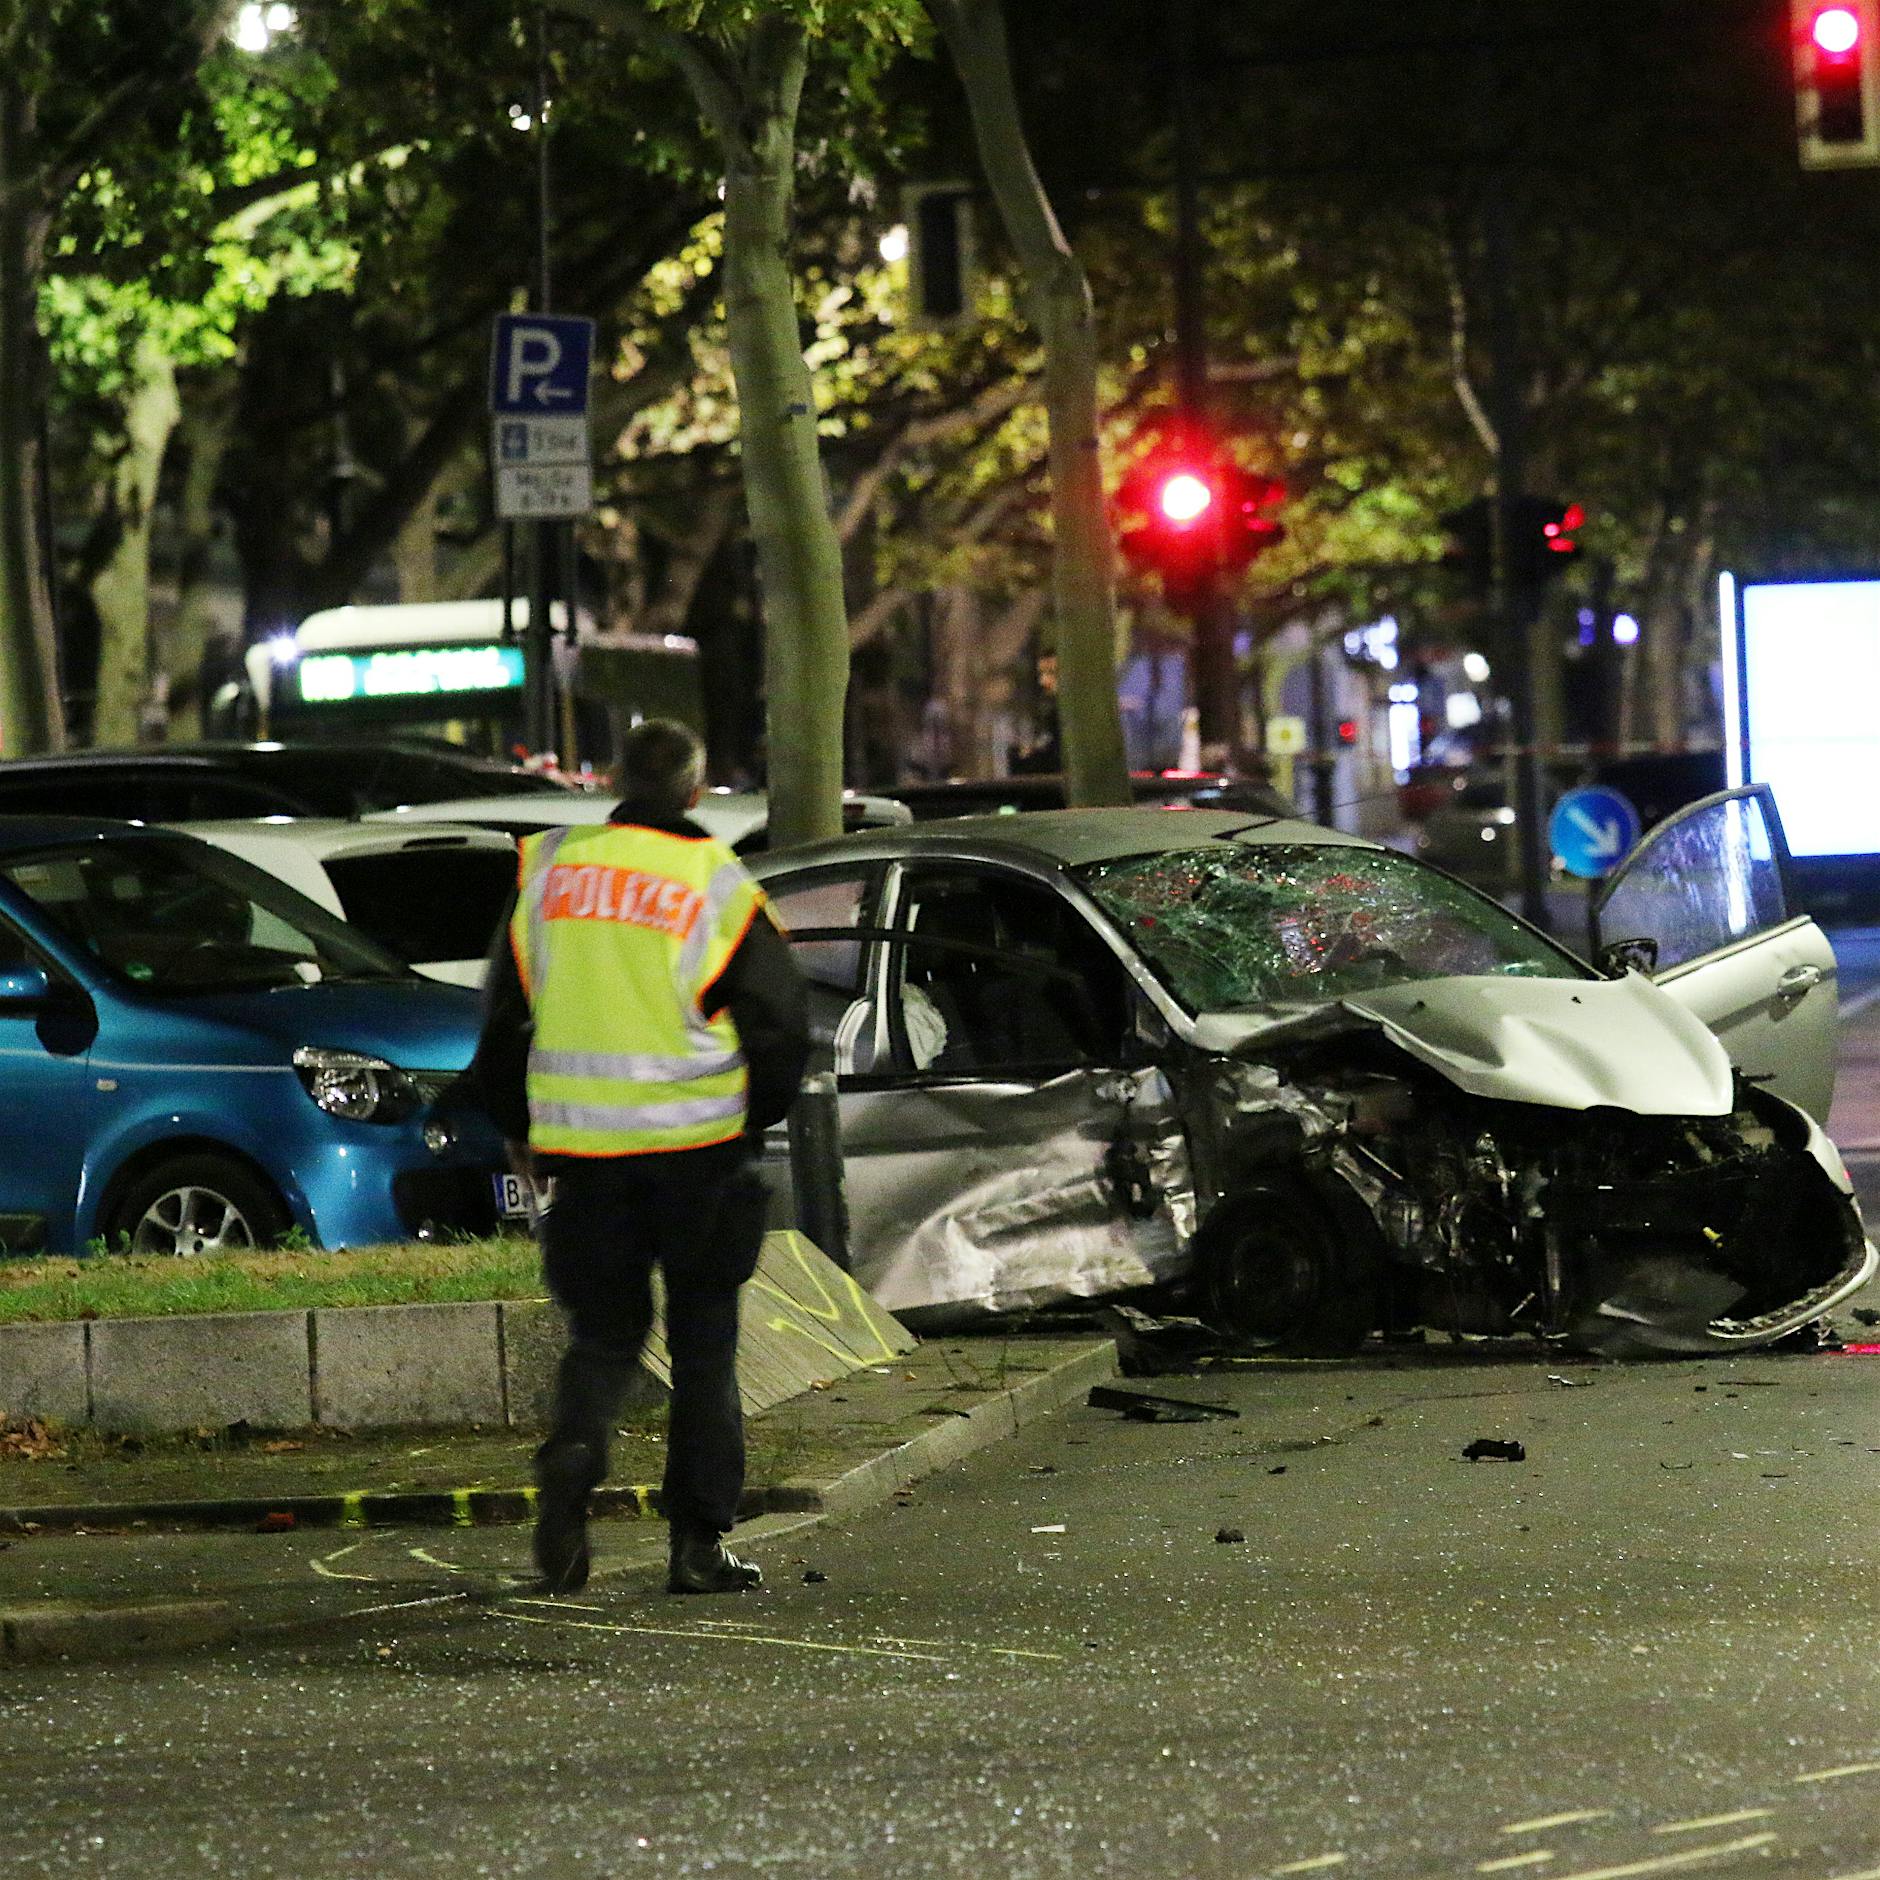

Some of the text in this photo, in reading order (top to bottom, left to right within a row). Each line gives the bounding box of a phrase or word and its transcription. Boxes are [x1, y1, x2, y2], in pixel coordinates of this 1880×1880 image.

[506, 327, 562, 403] P
[544, 865, 703, 935] POLIZEI
[506, 1179, 520, 1207] B
